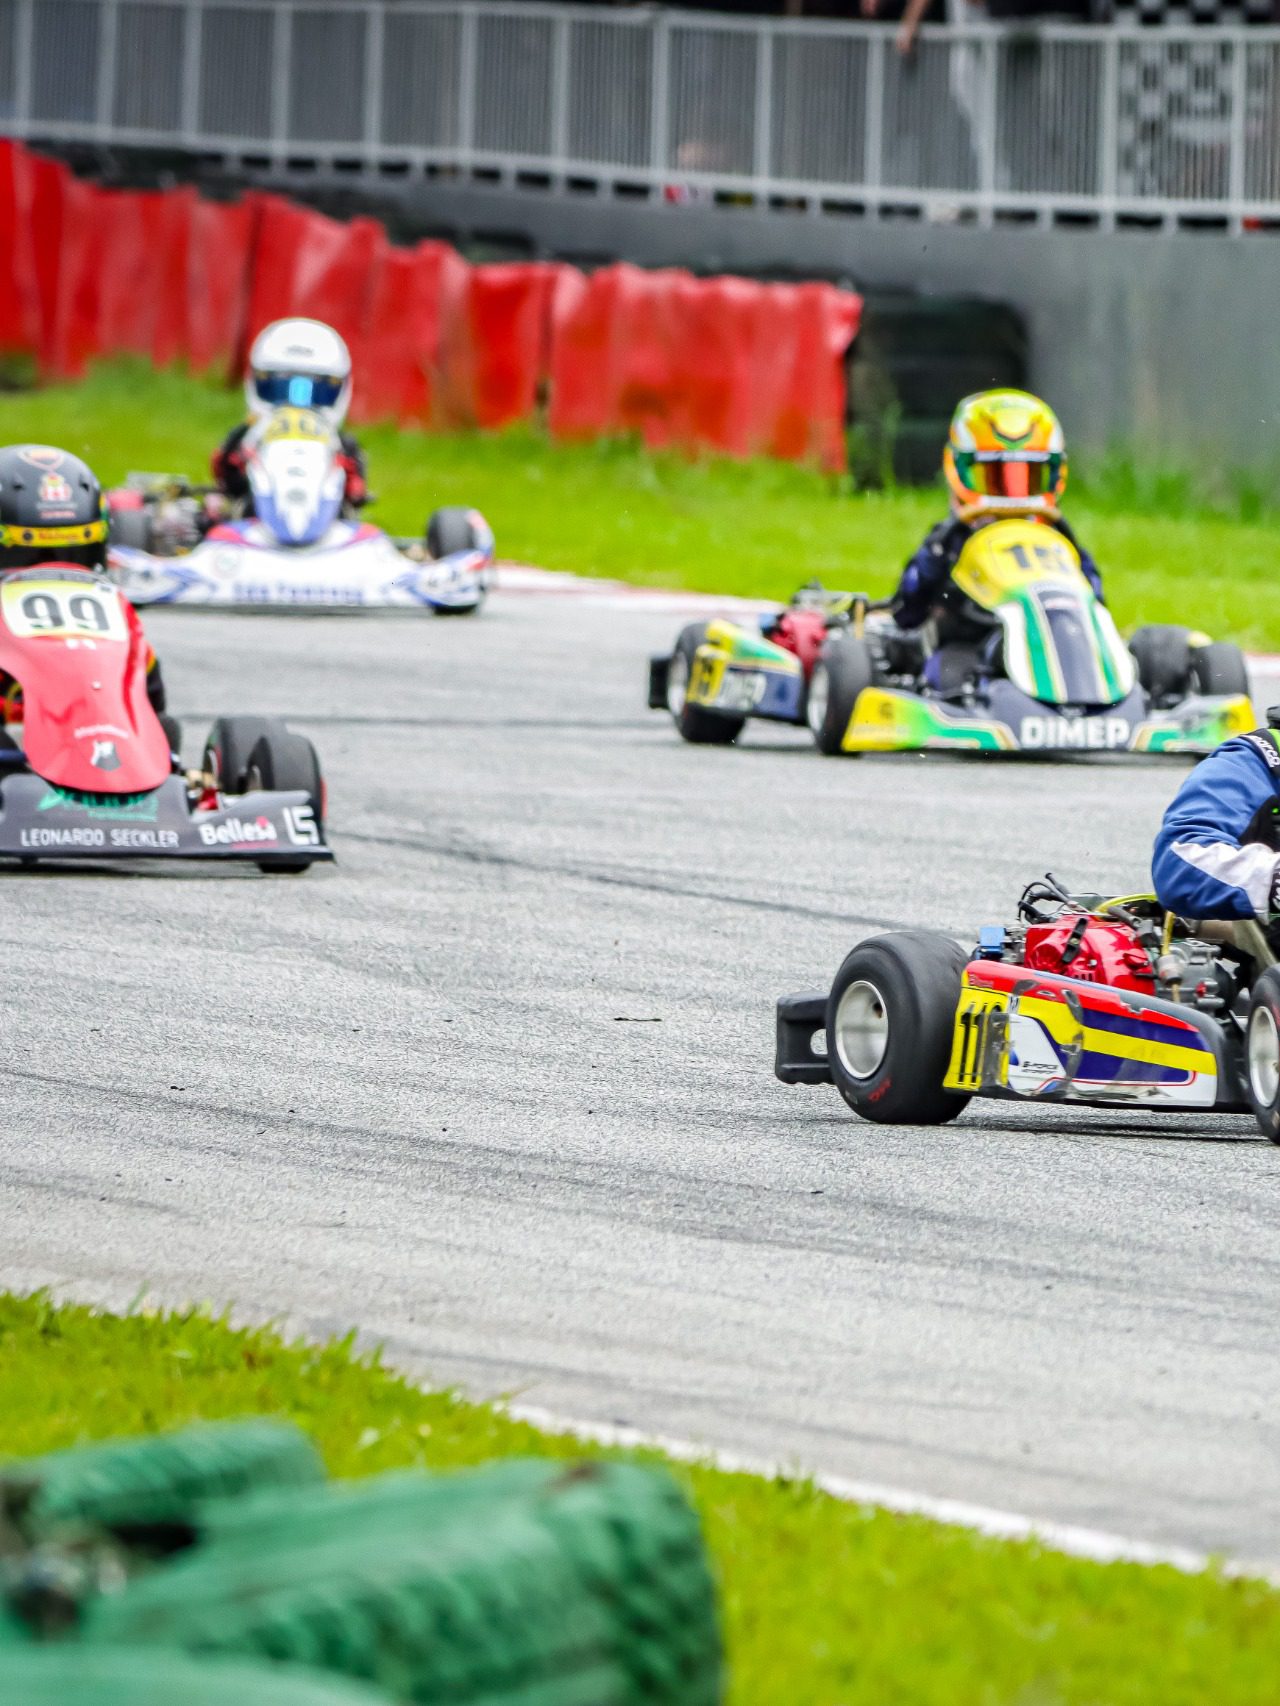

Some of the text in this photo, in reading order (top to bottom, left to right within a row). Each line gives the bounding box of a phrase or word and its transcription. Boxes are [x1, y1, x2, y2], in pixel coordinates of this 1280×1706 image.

[21, 592, 110, 631] 99
[1021, 716, 1130, 749] DIMEP
[21, 828, 180, 848] LEONARDO SECKLER
